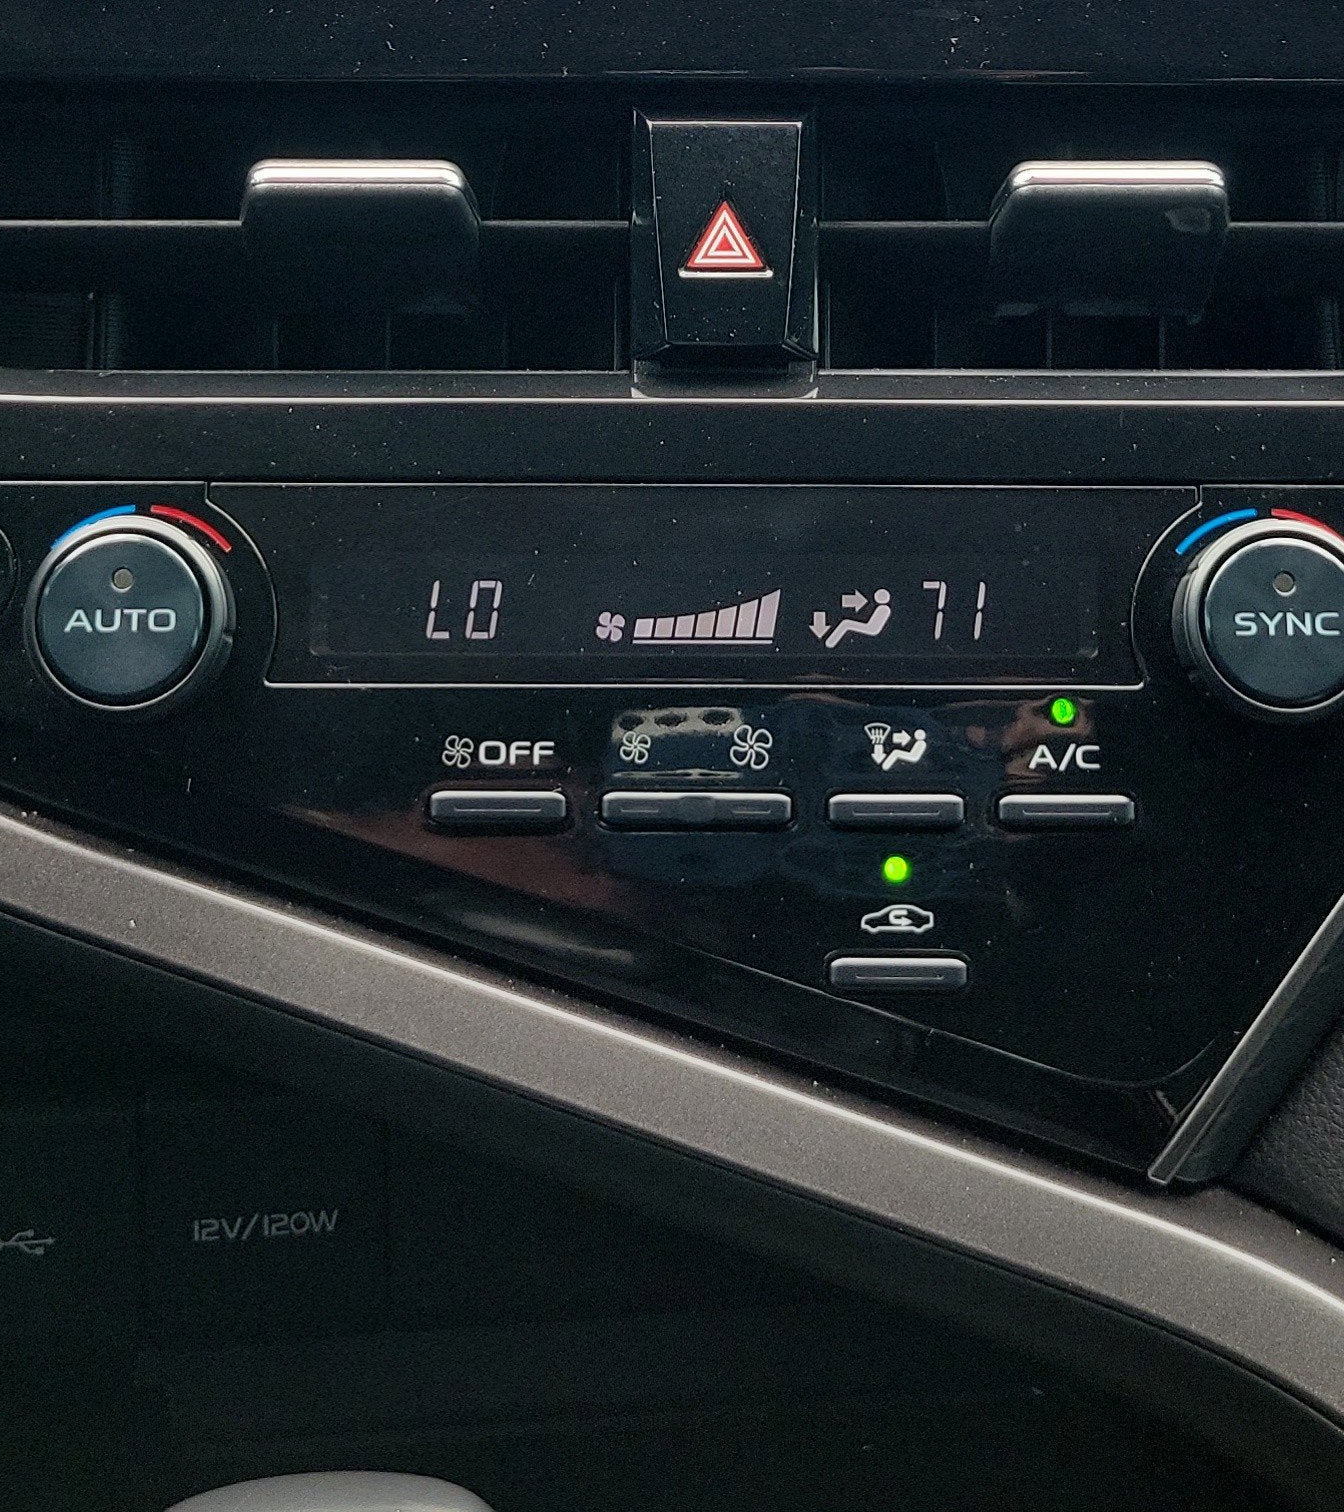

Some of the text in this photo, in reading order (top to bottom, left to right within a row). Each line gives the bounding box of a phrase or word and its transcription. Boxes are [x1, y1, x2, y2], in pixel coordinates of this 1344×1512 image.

[63, 608, 177, 633] AUTO
[922, 580, 987, 640] 71
[1233, 611, 1341, 637] SYNC
[477, 740, 555, 765] OFF
[1028, 744, 1101, 770] A/C
[193, 1209, 339, 1242] 12V/120W
